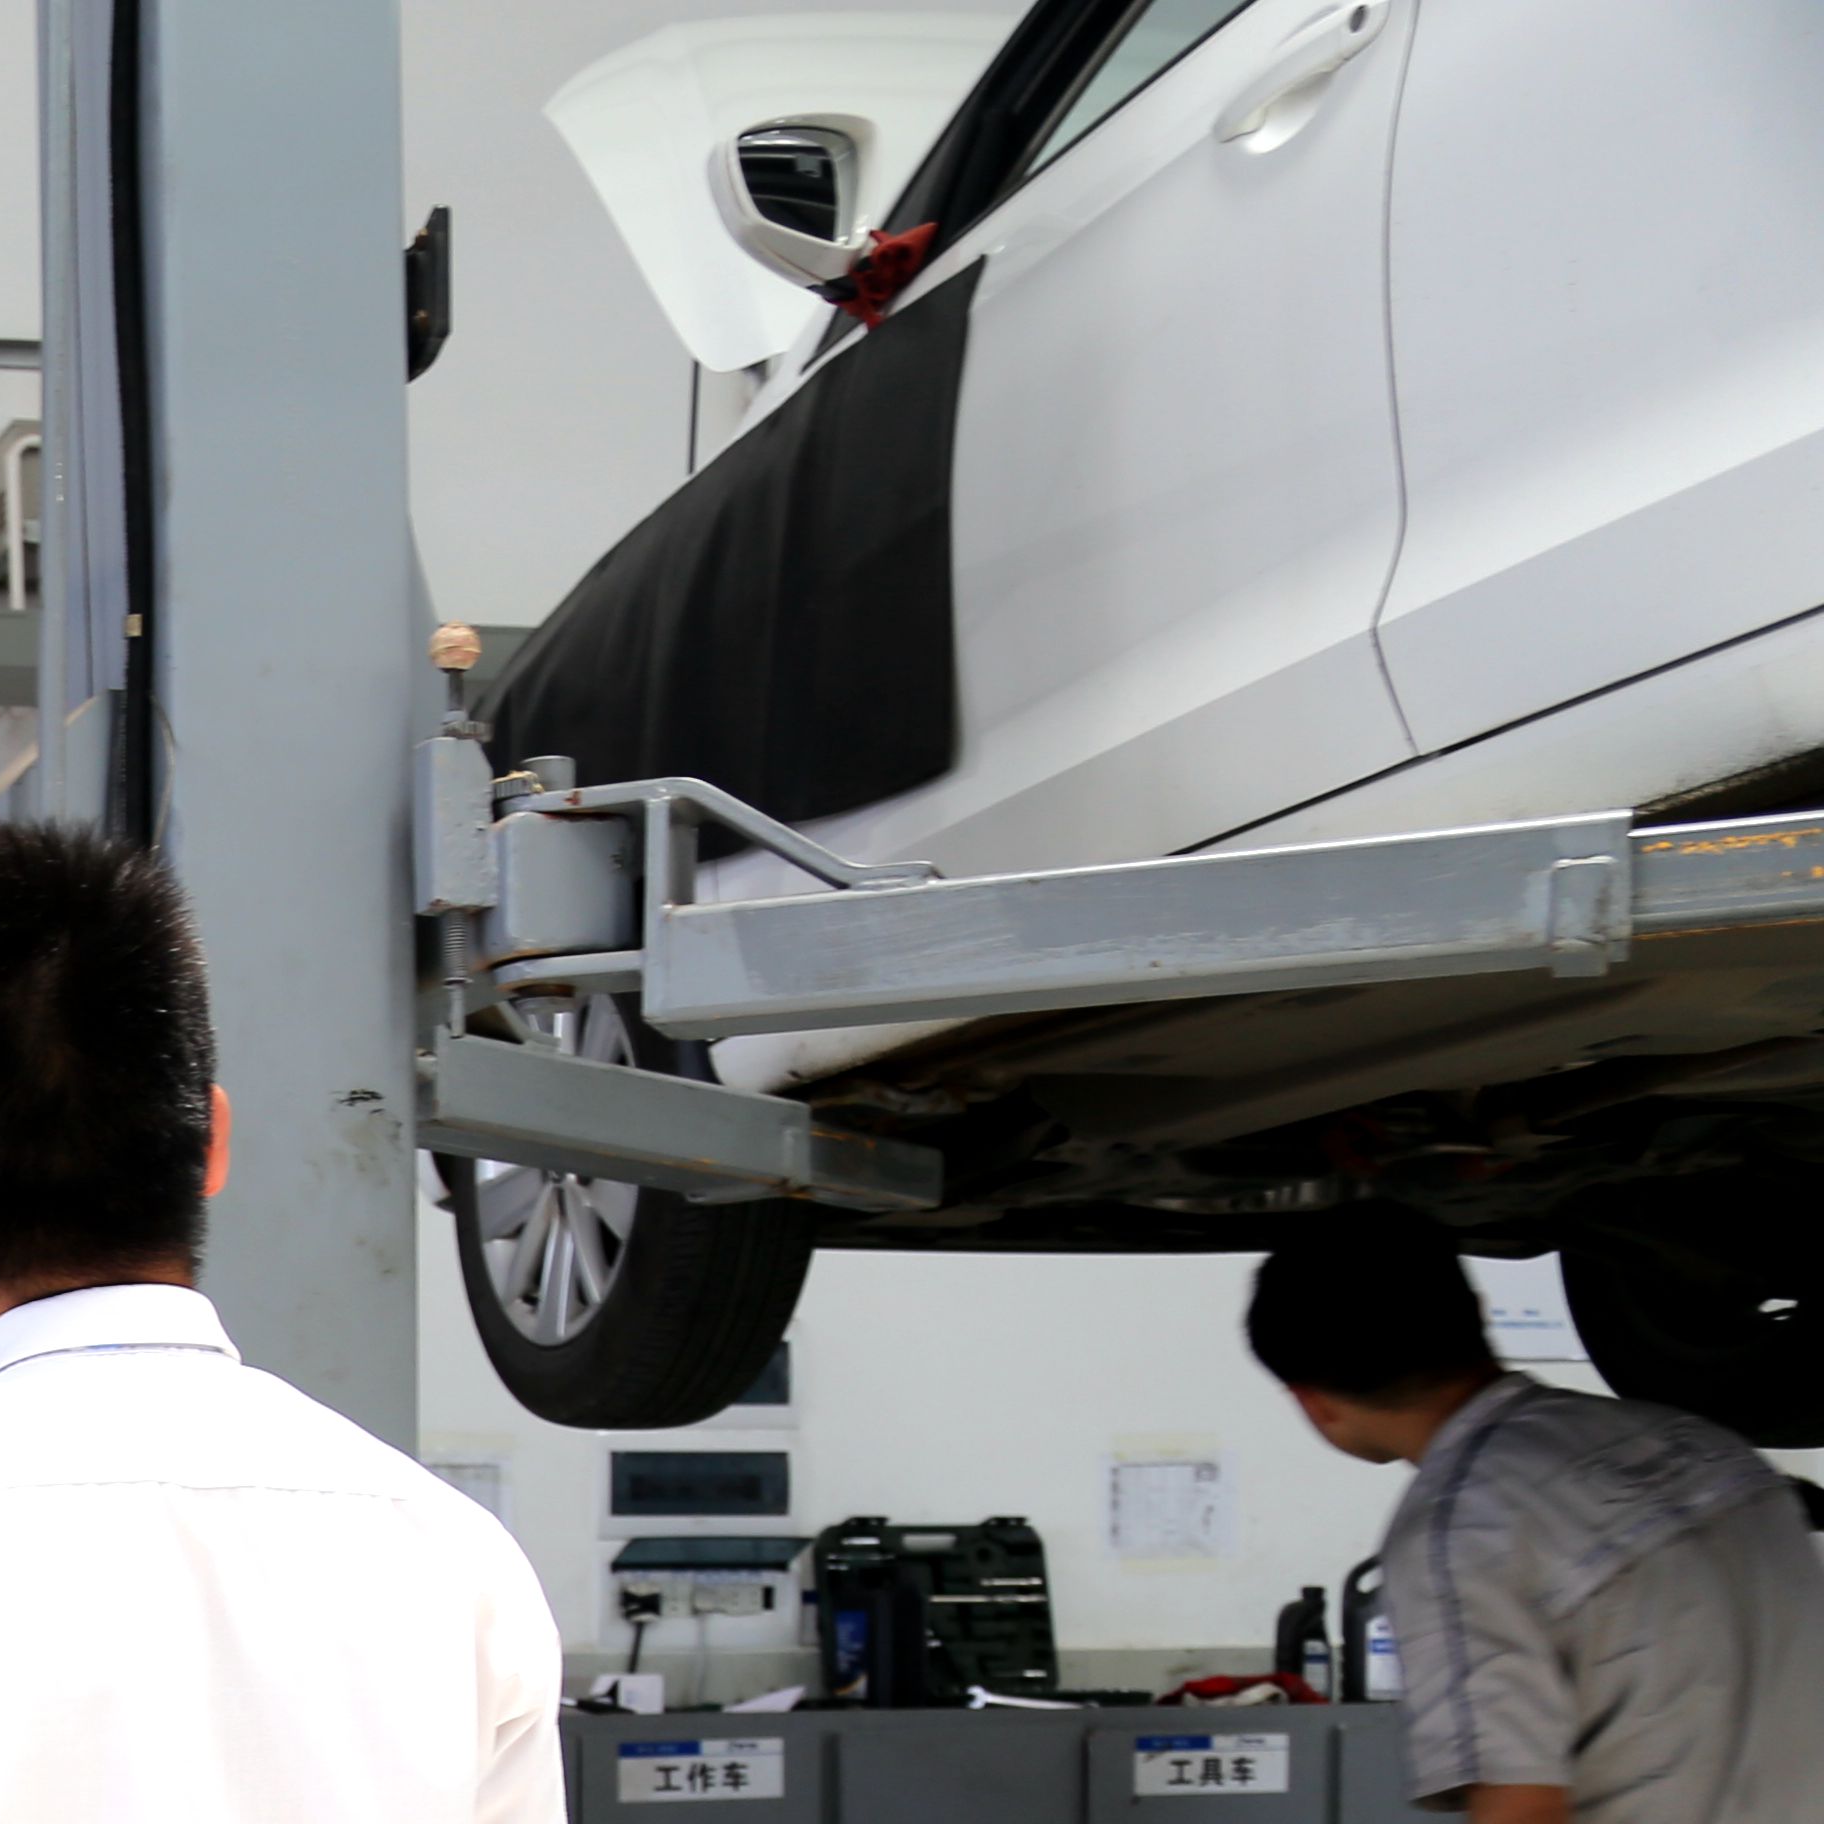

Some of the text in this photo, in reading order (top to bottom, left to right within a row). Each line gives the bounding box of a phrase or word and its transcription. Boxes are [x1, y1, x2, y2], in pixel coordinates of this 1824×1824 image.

[653, 1761, 750, 1792] 工作车
[1166, 1756, 1258, 1787] 工具车
